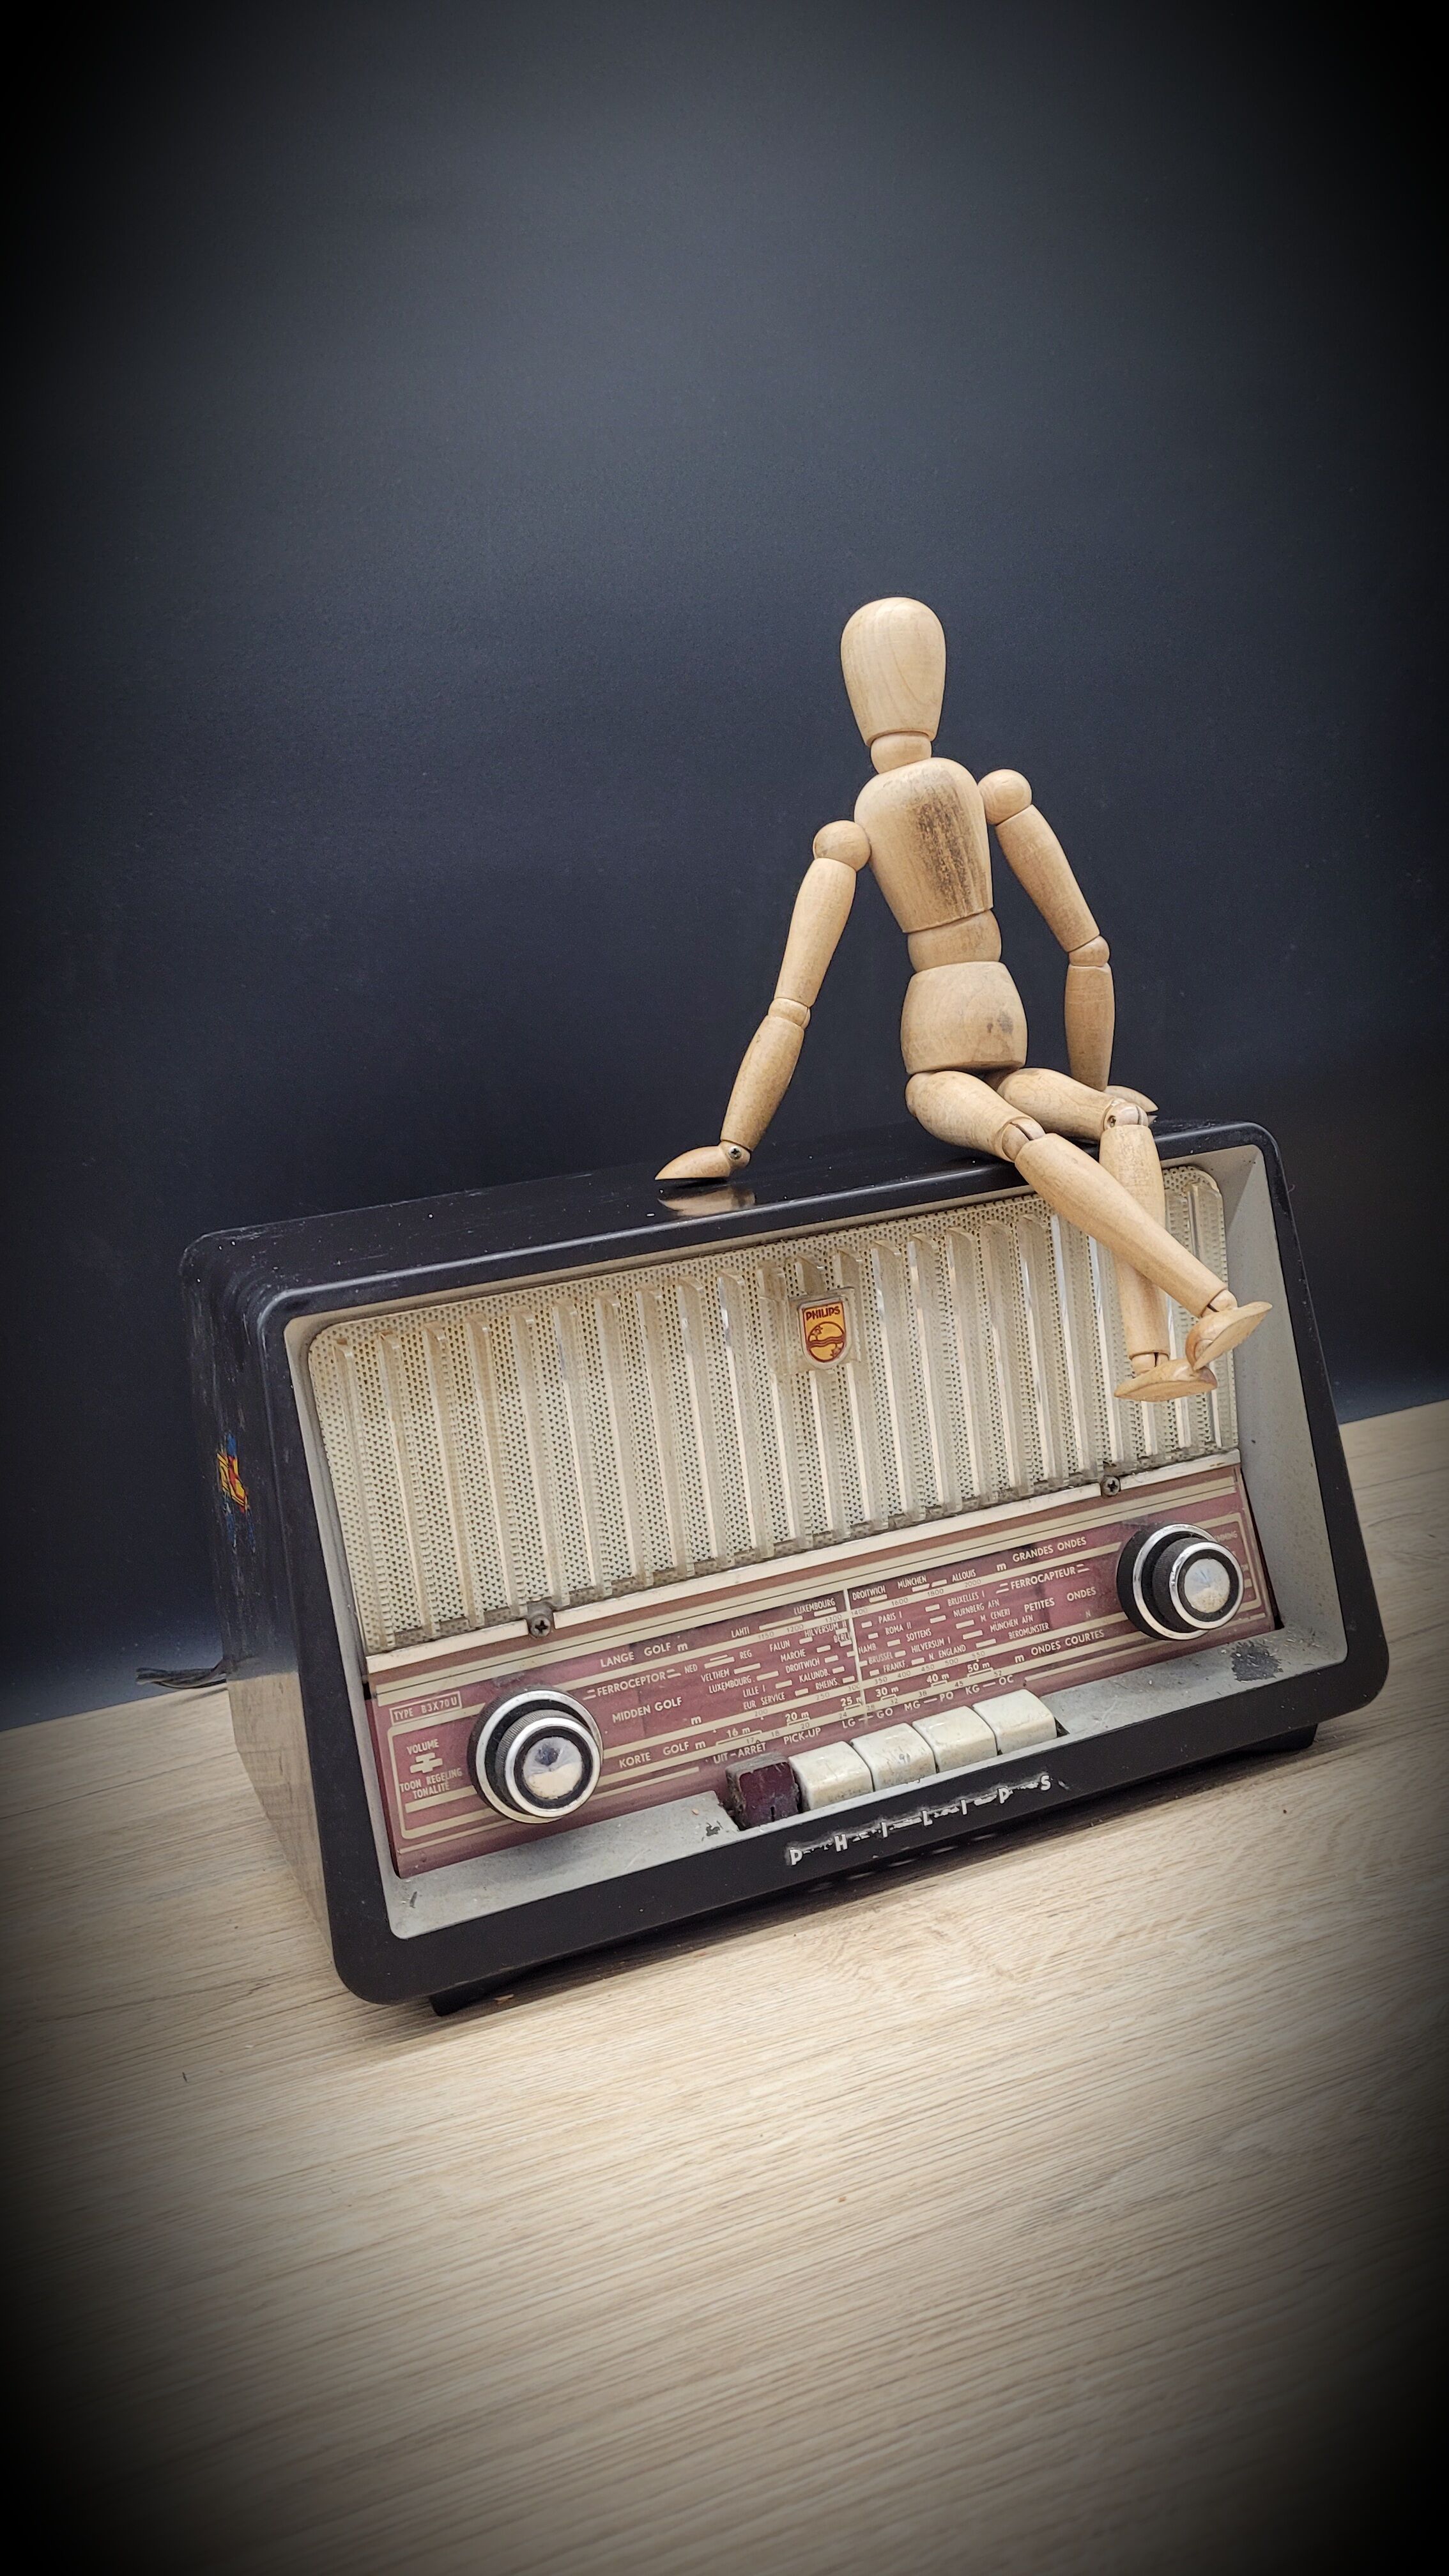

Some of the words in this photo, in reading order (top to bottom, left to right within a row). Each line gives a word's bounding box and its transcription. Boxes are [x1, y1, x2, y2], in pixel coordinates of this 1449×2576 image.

[805, 1306, 841, 1321] PHILIPS
[996, 1563, 1007, 1572] m
[1012, 1544, 1054, 1562] GRANDES
[1057, 1537, 1087, 1551] ONDES
[952, 1569, 976, 1583] ALLOUIS
[1010, 1566, 1076, 1590] FERROCAPTEUR
[852, 1585, 886, 1601] DROITWICH
[947, 1591, 979, 1607] BRUXELLES
[1024, 1598, 1055, 1613] PETITES
[1067, 1586, 1096, 1602] ONDES
[758, 1631, 774, 1640] 1150
[786, 1625, 804, 1633] 1200
[825, 1614, 842, 1623] 1300
[851, 1607, 868, 1616] 1400
[891, 1597, 908, 1606] 1600
[927, 1588, 944, 1597] 1800
[965, 1579, 981, 1588] 2000
[793, 1598, 836, 1615] LUXEMBOURG
[988, 1598, 1000, 1609] AFN
[878, 1613, 896, 1624] PARIS
[991, 1608, 1011, 1620] CENERI
[1022, 1614, 1033, 1624] AFN
[731, 1626, 750, 1638] LAHTI
[804, 1622, 839, 1637] HILVERSUM
[885, 1624, 903, 1636] ROMA
[906, 1628, 932, 1642] SOTTENS
[769, 1639, 790, 1652] FALUN
[858, 1643, 877, 1654] HAMB
[911, 1637, 945, 1653] HILVERSUM
[939, 1644, 967, 1658] ENGLAND
[1015, 1655, 1025, 1663] m
[1031, 1640, 1061, 1656] ONDES
[1065, 1629, 1105, 1646] COURTES
[599, 1651, 634, 1668] LANGE
[643, 1642, 671, 1657] GOLF
[677, 1643, 688, 1652] m
[739, 1650, 752, 1659] REG
[780, 1649, 806, 1662] MARCHE
[868, 1652, 893, 1665] BRUSSEL
[684, 1664, 698, 1675] NED
[785, 1658, 820, 1673] DROITWICH
[967, 1663, 979, 1673] 50
[700, 1668, 730, 1682] VELTHEM
[799, 1669, 831, 1683] KALUNDB.
[926, 1673, 939, 1683] 40
[597, 1671, 666, 1697] FERROCEPTOR
[754, 1708, 767, 1717] 200
[875, 1676, 887, 1685] 350
[898, 1670, 911, 1678] 400
[921, 1664, 935, 1673] 450
[742, 1687, 760, 1698] LILLE
[875, 1687, 888, 1698] 30
[743, 1701, 756, 1710] EUR
[760, 1692, 786, 1706] SERVICE
[840, 1696, 853, 1706] 25
[394, 1708, 413, 1721] TYPE
[612, 1705, 651, 1723] MIDDEN
[654, 1697, 682, 1712] GOLF
[690, 1715, 702, 1725] m
[785, 1713, 797, 1723] 20
[726, 1728, 739, 1738] 16
[783, 1728, 821, 1745] PICK-UP
[406, 1739, 440, 1755] VOLUME
[619, 1752, 651, 1769] KORTE
[663, 1742, 690, 1756] GOLF
[695, 1741, 706, 1749] m
[399, 1779, 422, 1793] TOON
[425, 1768, 463, 1785] REGELING
